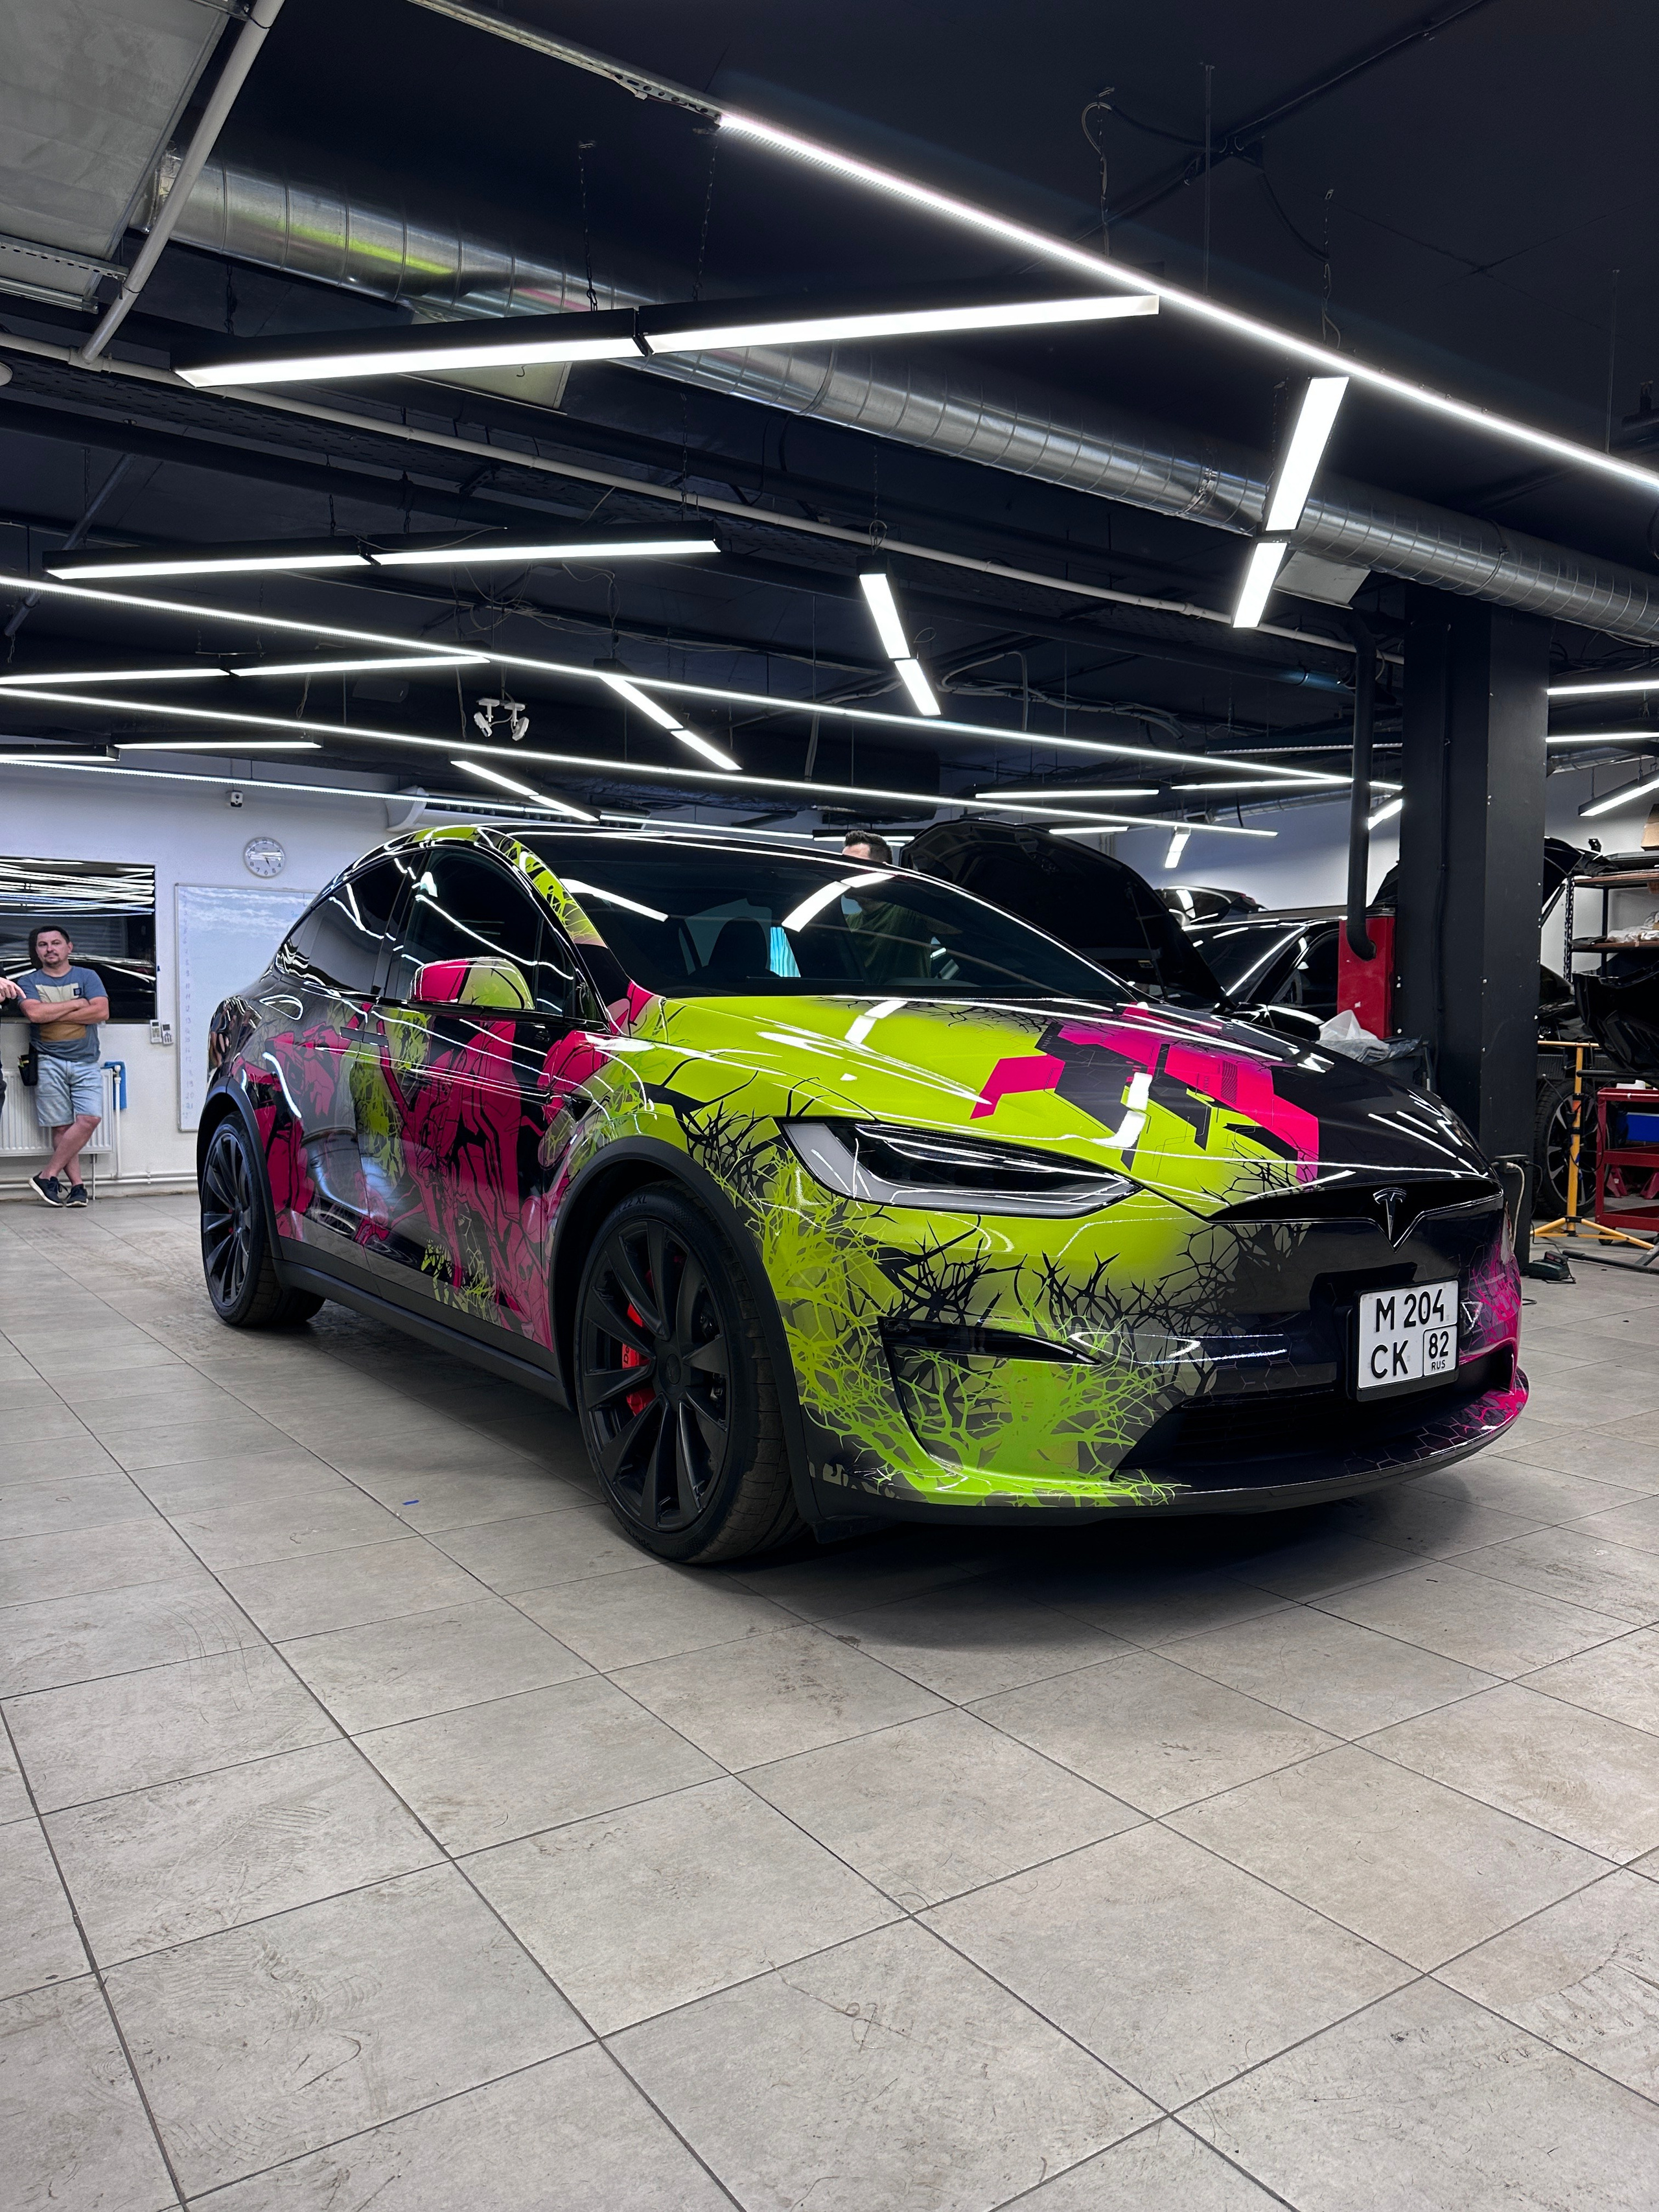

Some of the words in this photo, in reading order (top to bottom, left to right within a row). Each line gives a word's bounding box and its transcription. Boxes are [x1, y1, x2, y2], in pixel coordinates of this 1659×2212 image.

[636, 1195, 647, 1205] XL
[1375, 1296, 1395, 1333] M
[1404, 1288, 1444, 1328] 204
[1428, 1331, 1449, 1359] 82
[1371, 1340, 1409, 1379] CK
[1431, 1359, 1446, 1371] RUS
